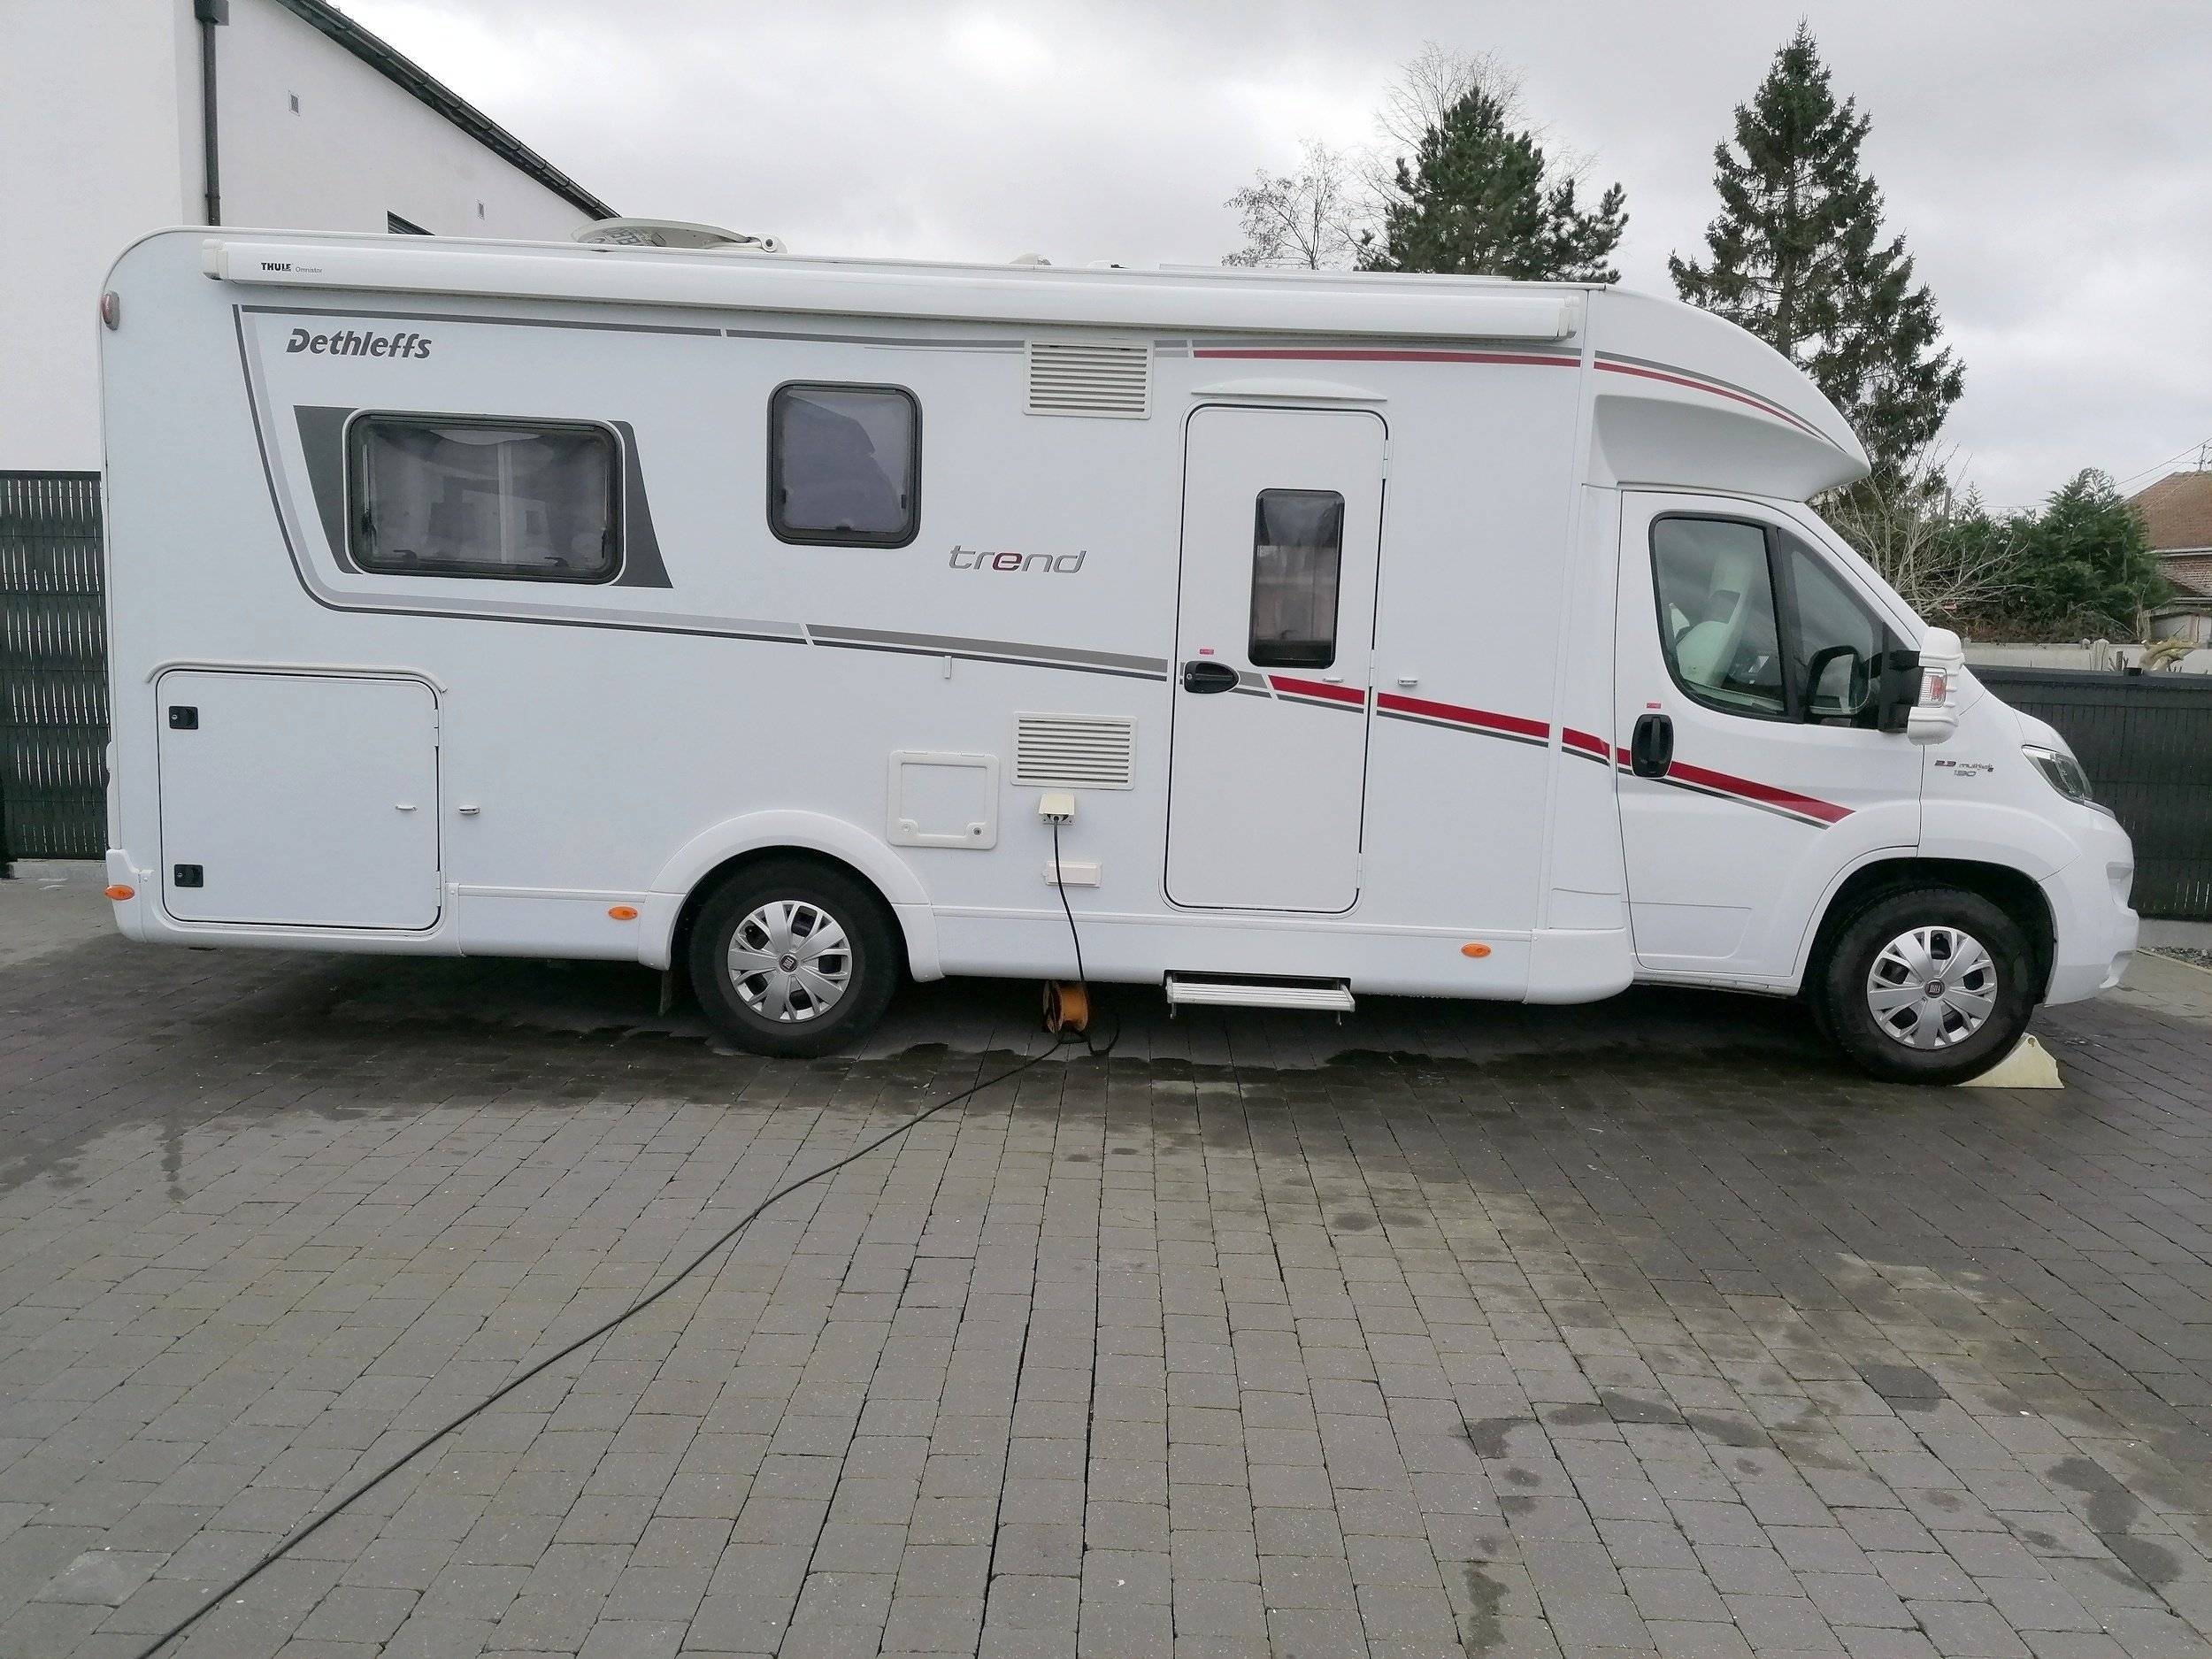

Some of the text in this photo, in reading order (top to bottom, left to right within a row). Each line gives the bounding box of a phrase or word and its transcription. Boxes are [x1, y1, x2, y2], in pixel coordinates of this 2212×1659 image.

[261, 262, 292, 272] THULE
[286, 327, 433, 359] Dethleffs
[949, 545, 1087, 574] trend
